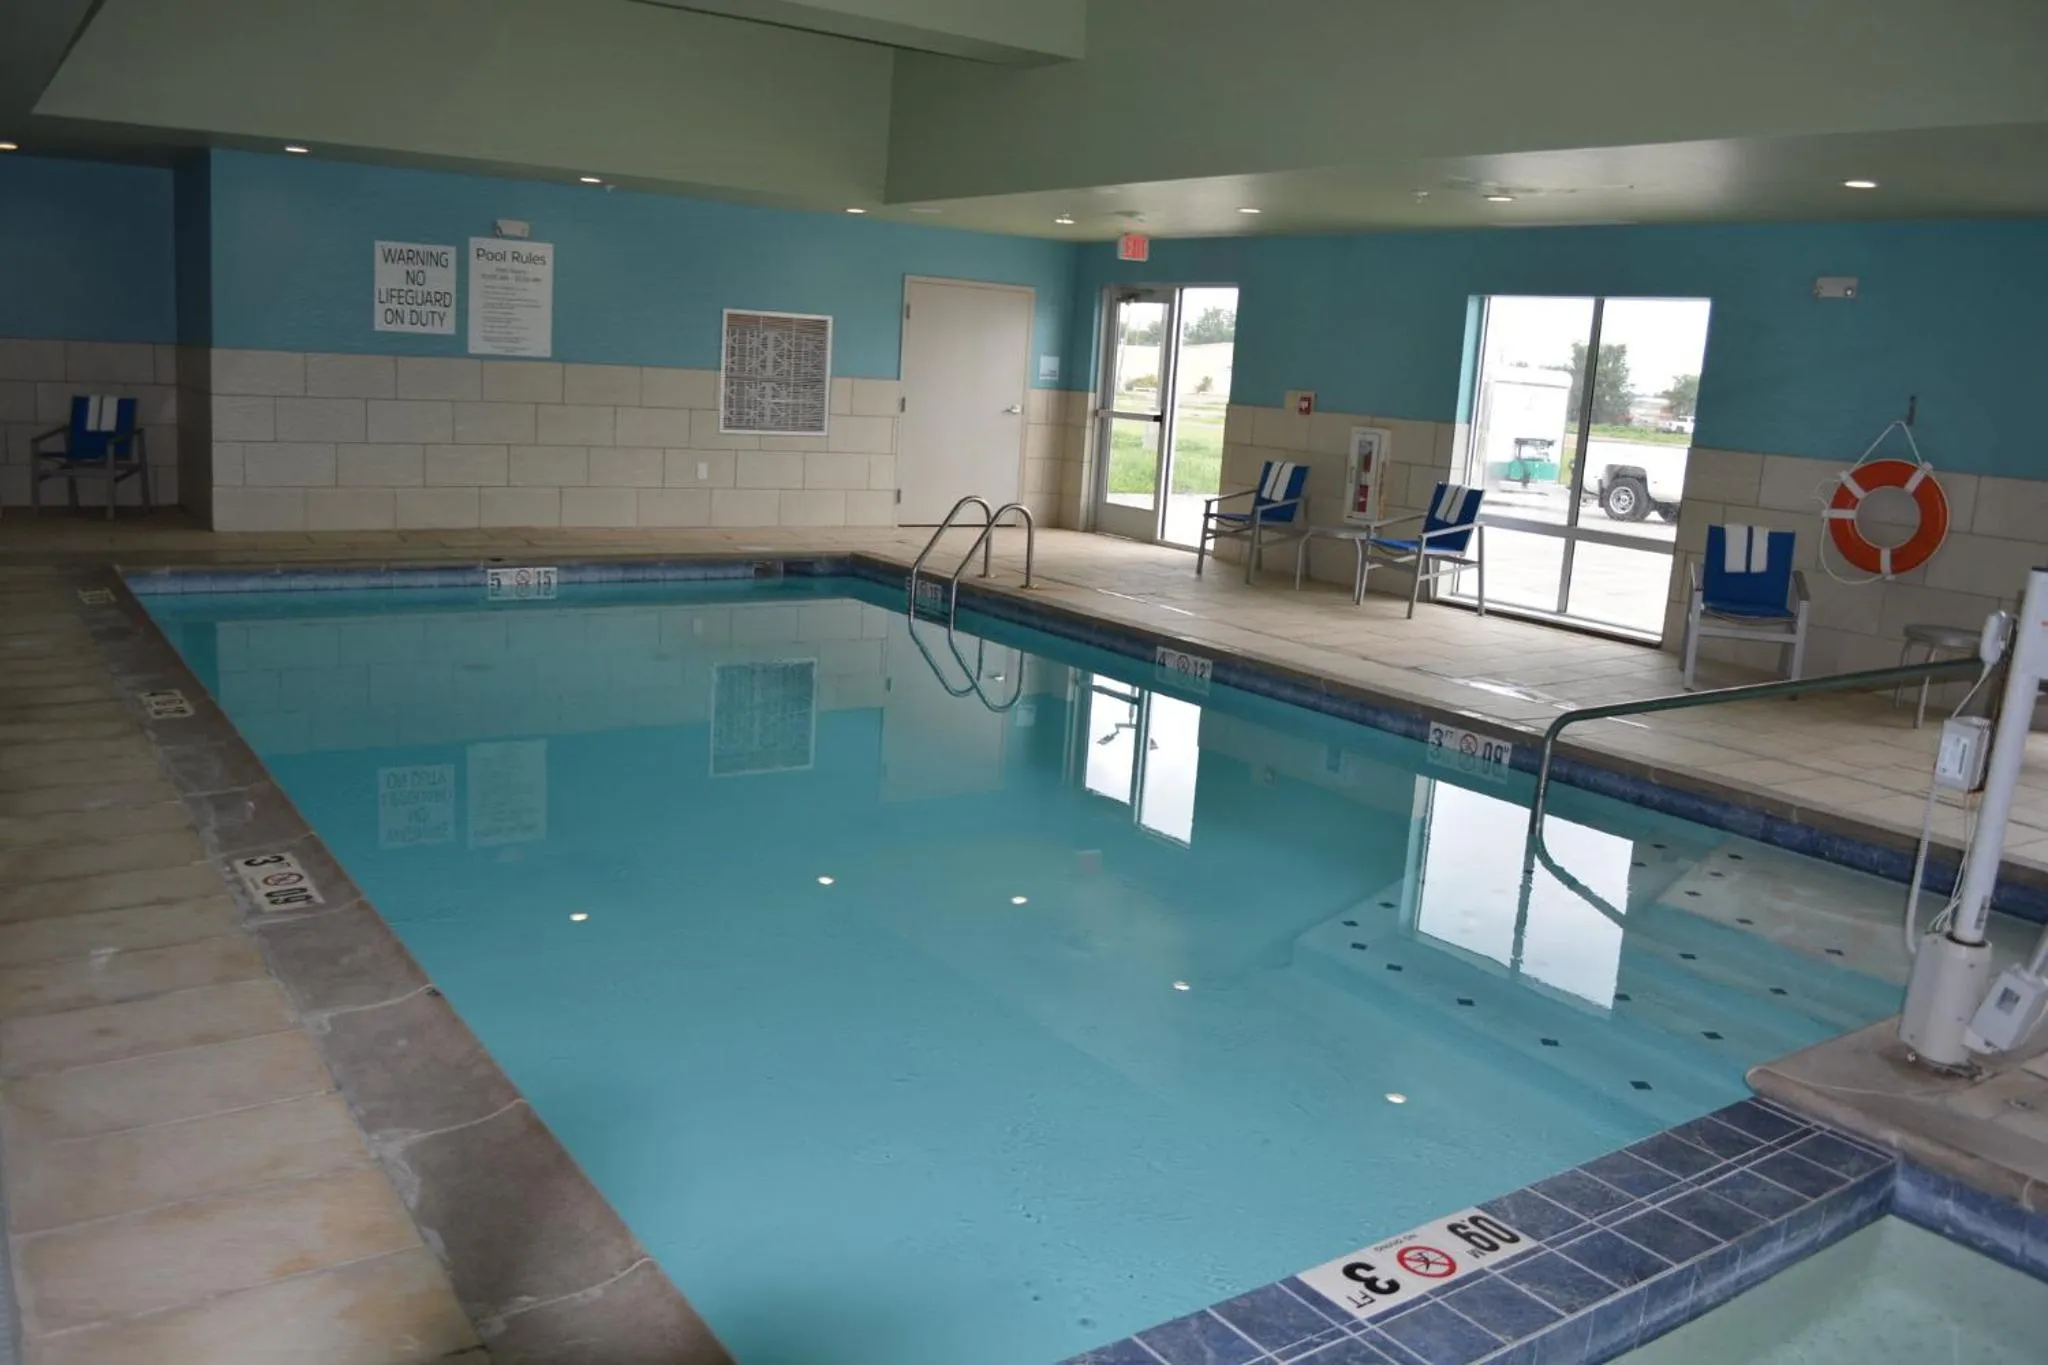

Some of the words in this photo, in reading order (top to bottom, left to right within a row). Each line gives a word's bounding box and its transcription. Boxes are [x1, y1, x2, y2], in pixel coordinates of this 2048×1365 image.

[382, 247, 449, 268] WARNING
[476, 247, 506, 262] Pool
[511, 250, 547, 266] Rules
[405, 269, 426, 286] NO
[378, 288, 453, 308] LIFEGUARD
[384, 308, 405, 325] ON
[410, 309, 446, 328] DUTY
[490, 571, 502, 588] 5
[1431, 728, 1443, 747] 3
[244, 855, 285, 867] 3
[1342, 1262, 1401, 1295] 3
